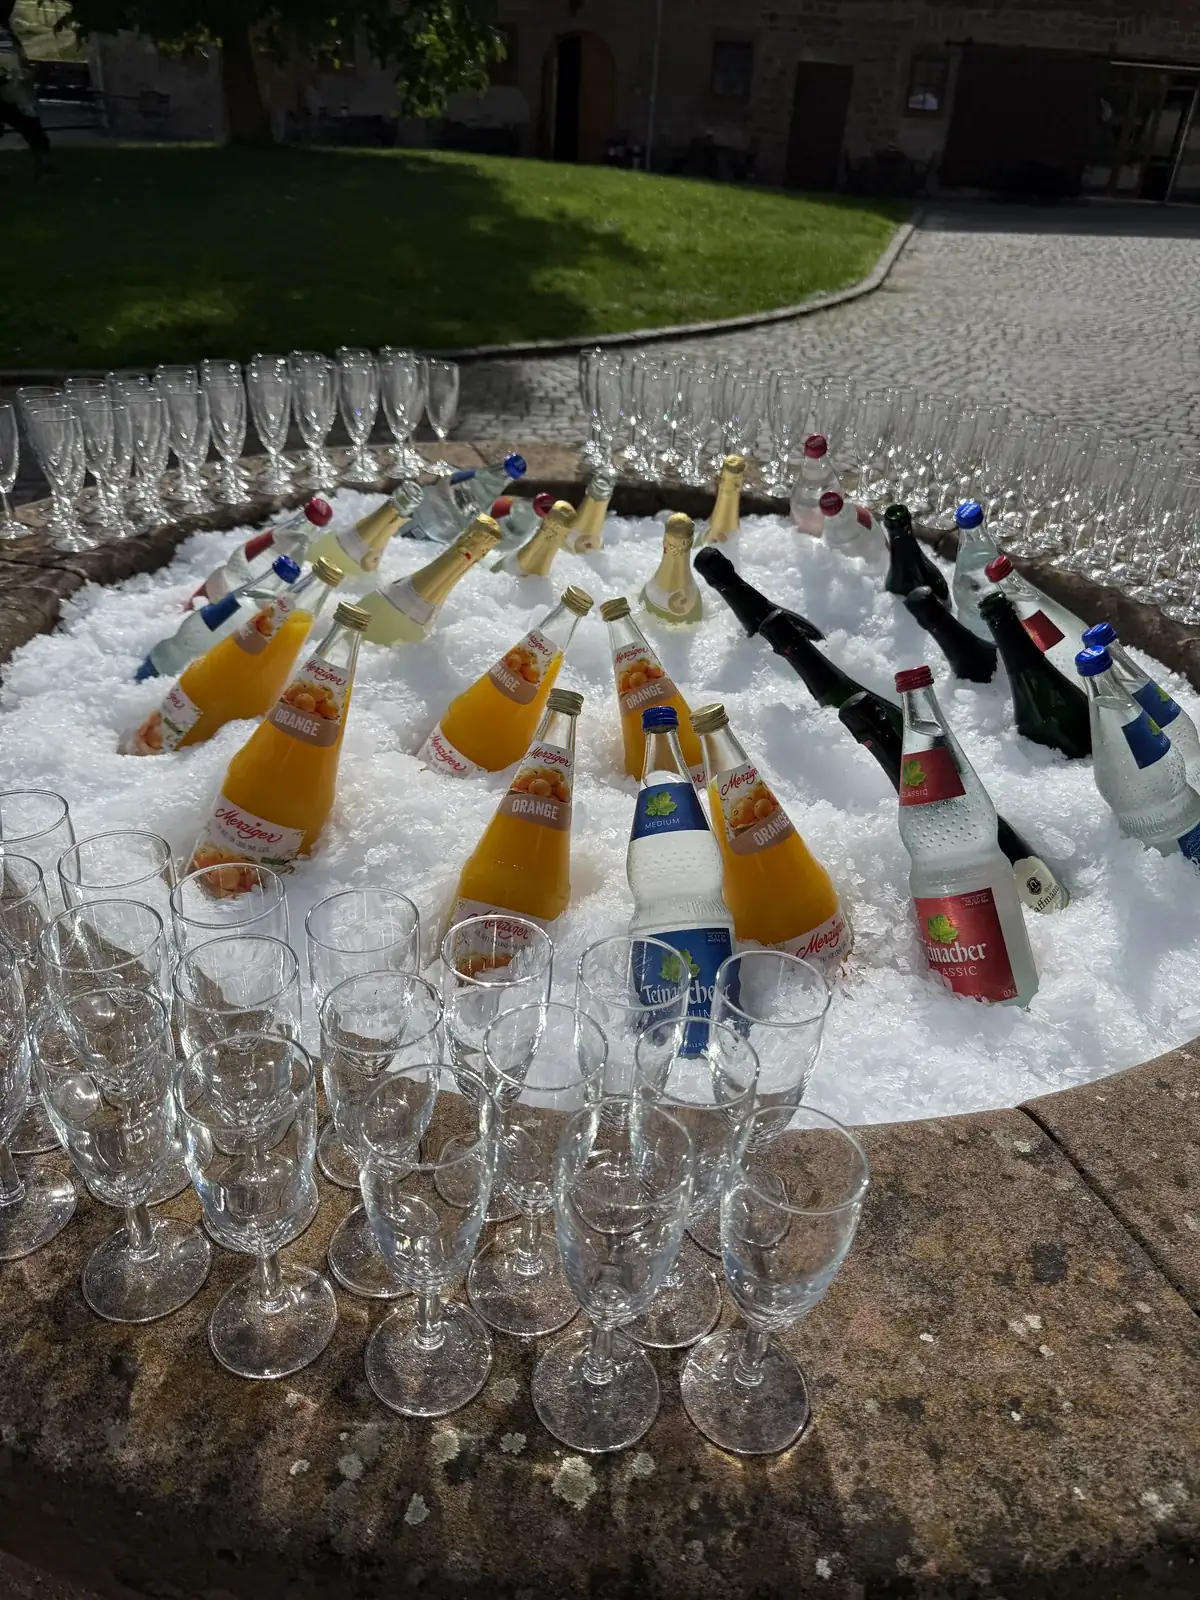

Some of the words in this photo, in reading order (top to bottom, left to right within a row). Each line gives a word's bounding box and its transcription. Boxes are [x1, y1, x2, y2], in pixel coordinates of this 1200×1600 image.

[615, 646, 649, 664] Merziger
[304, 660, 347, 686] Merziger
[626, 683, 665, 710] ORANGE
[274, 708, 321, 737] ORANGE
[429, 735, 467, 771] Merziger
[524, 746, 572, 768] Merziger
[512, 799, 559, 820] ORANGE
[215, 808, 283, 843] Merziger
[644, 817, 680, 830] MEDIUM
[752, 811, 791, 847] ORANGE
[1030, 884, 1060, 913] affmann
